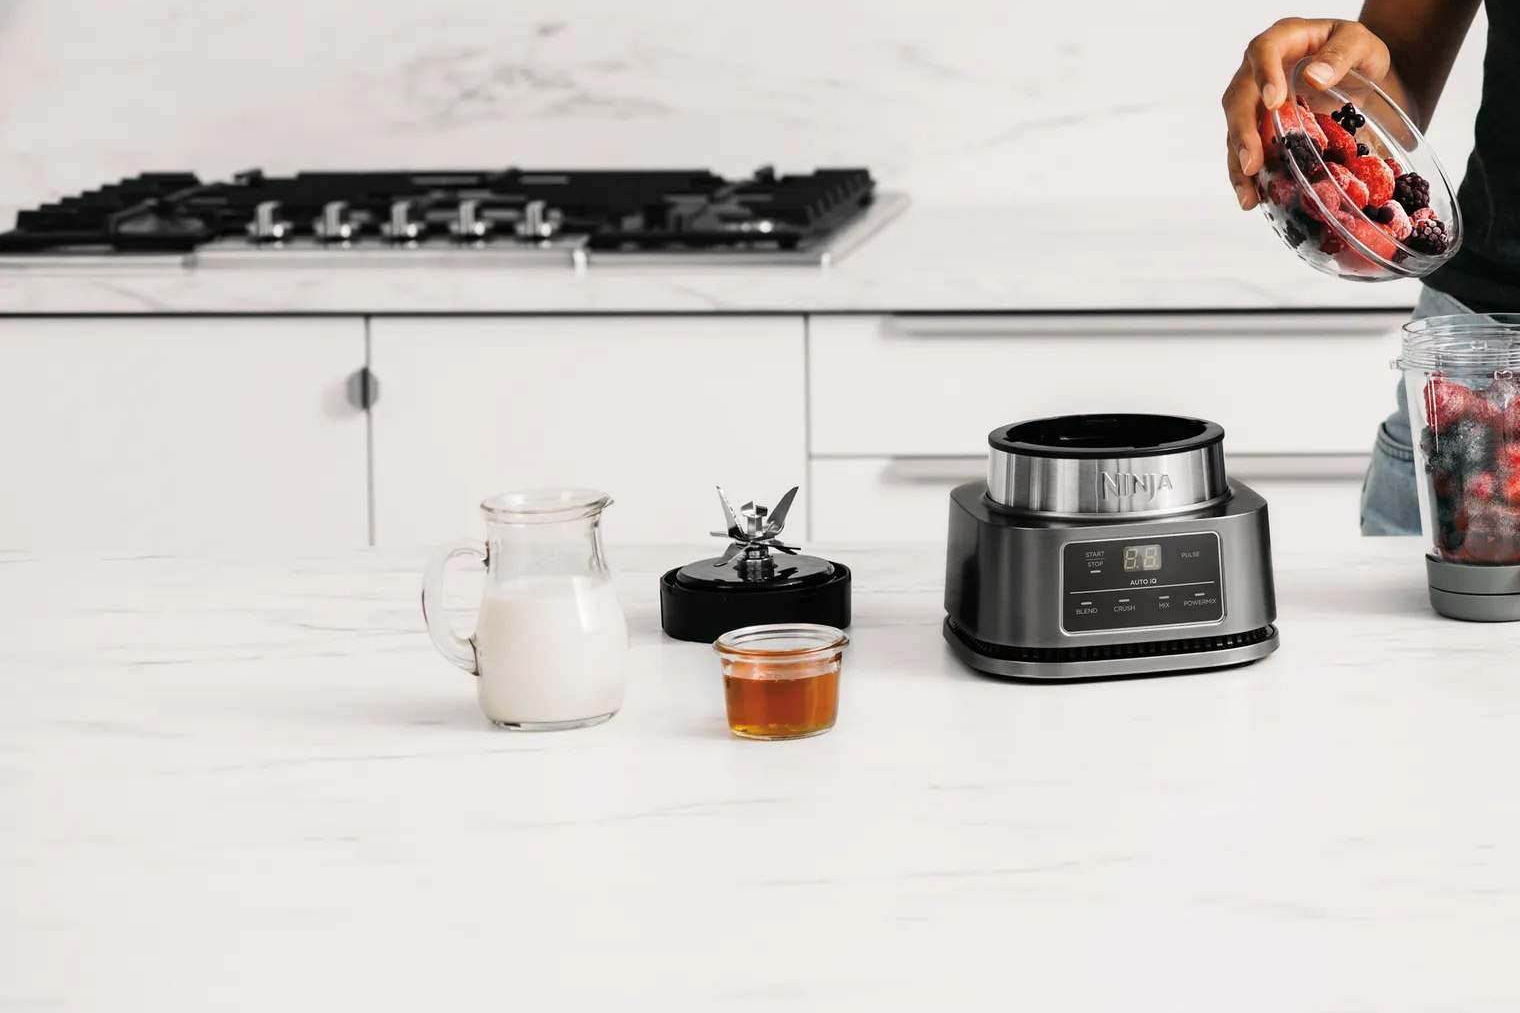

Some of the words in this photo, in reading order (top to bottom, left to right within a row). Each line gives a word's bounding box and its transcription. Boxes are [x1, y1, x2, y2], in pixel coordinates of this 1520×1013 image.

[1102, 471, 1174, 502] NINJA
[1085, 550, 1105, 558] START
[1181, 551, 1200, 559] PULSE
[1129, 578, 1149, 586] AUTO
[1183, 598, 1217, 607] POWERMIX
[1076, 607, 1099, 615] BLEND
[1113, 604, 1136, 612] CRUSH
